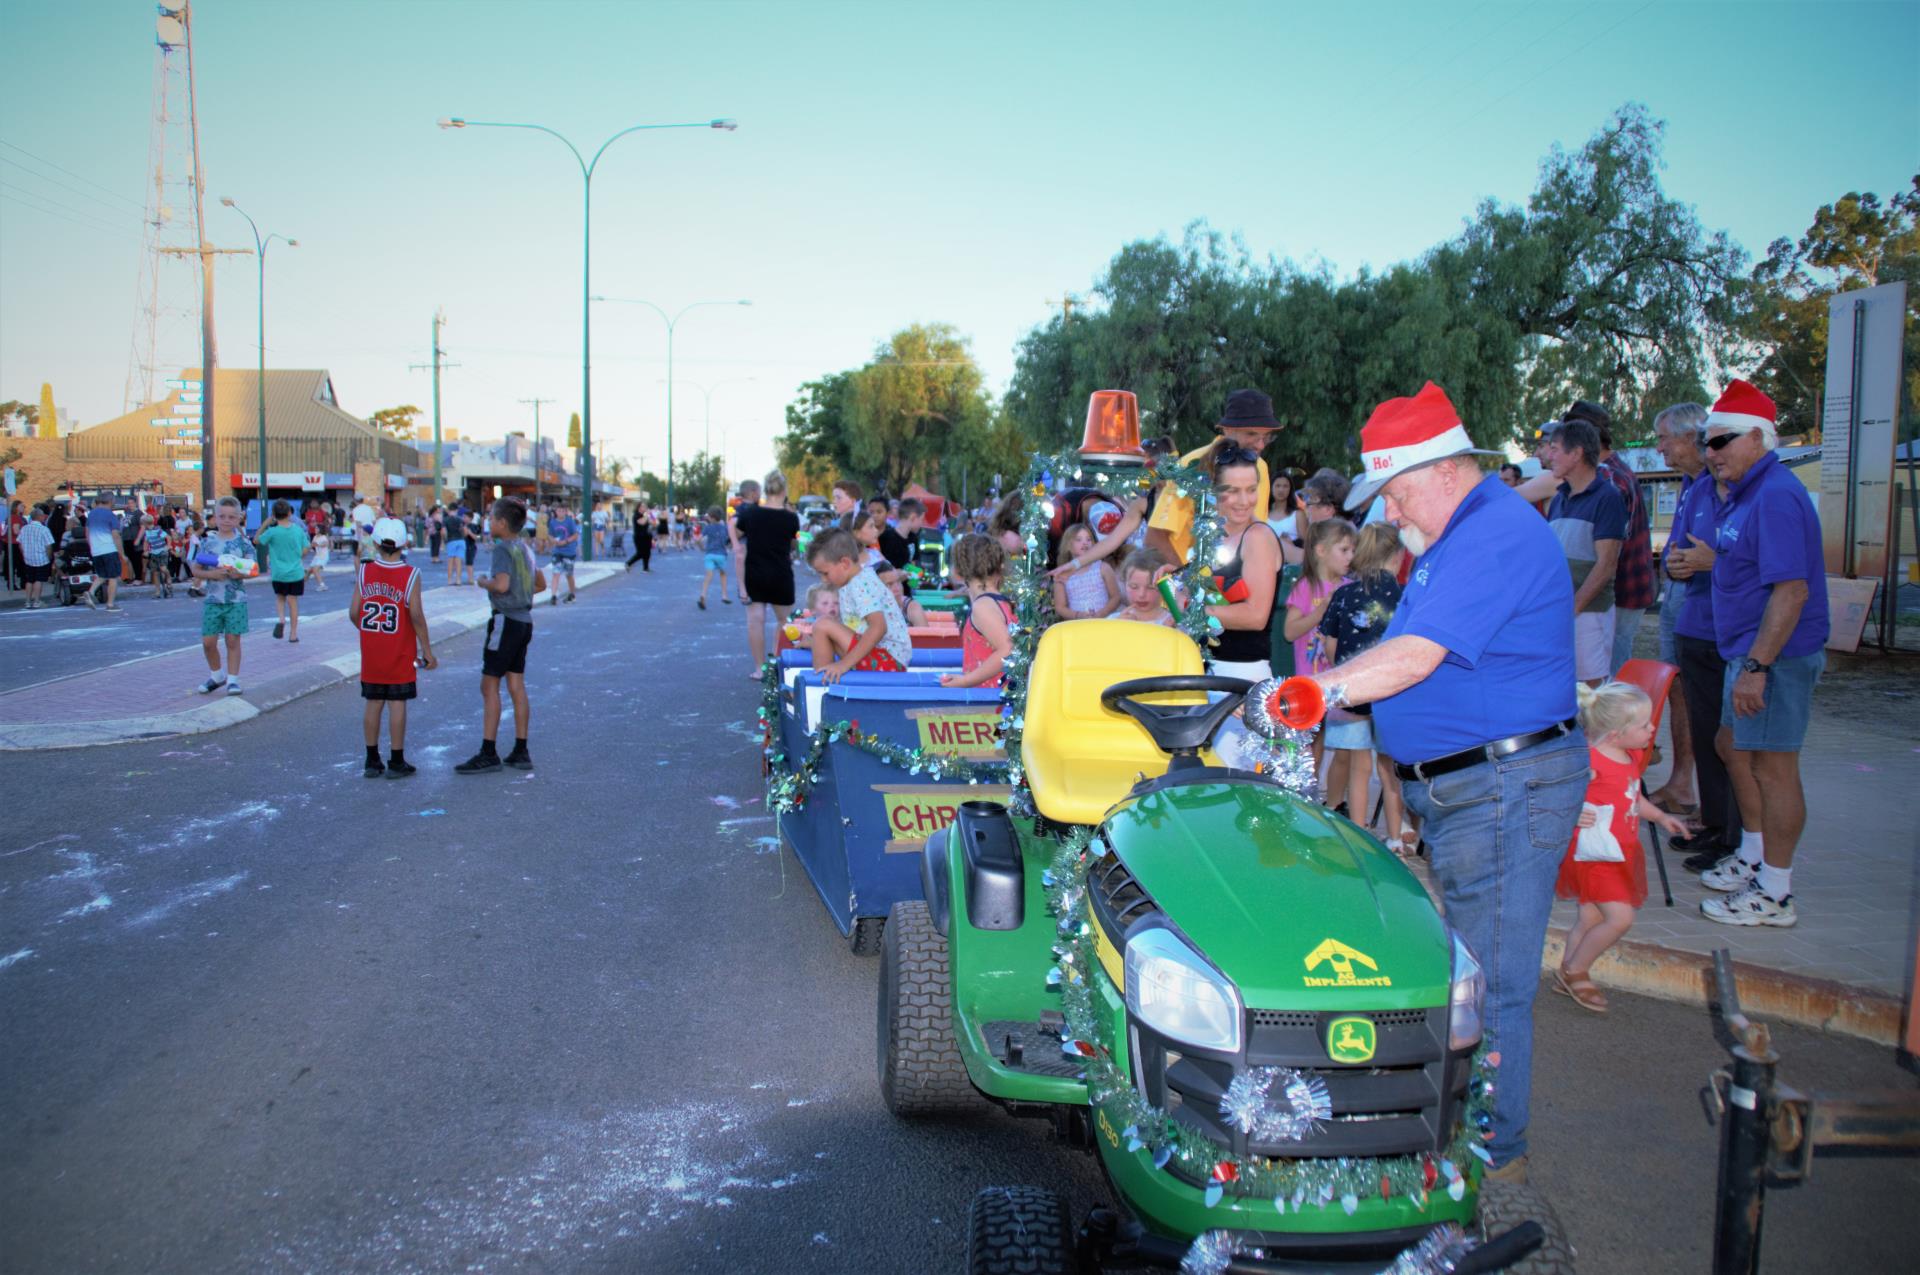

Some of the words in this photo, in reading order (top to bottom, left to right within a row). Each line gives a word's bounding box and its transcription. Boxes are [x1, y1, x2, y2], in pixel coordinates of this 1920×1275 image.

[1373, 455, 1393, 470] Ho!
[362, 582, 404, 604] JORDAN
[361, 601, 399, 634] 23
[928, 721, 999, 745] MER
